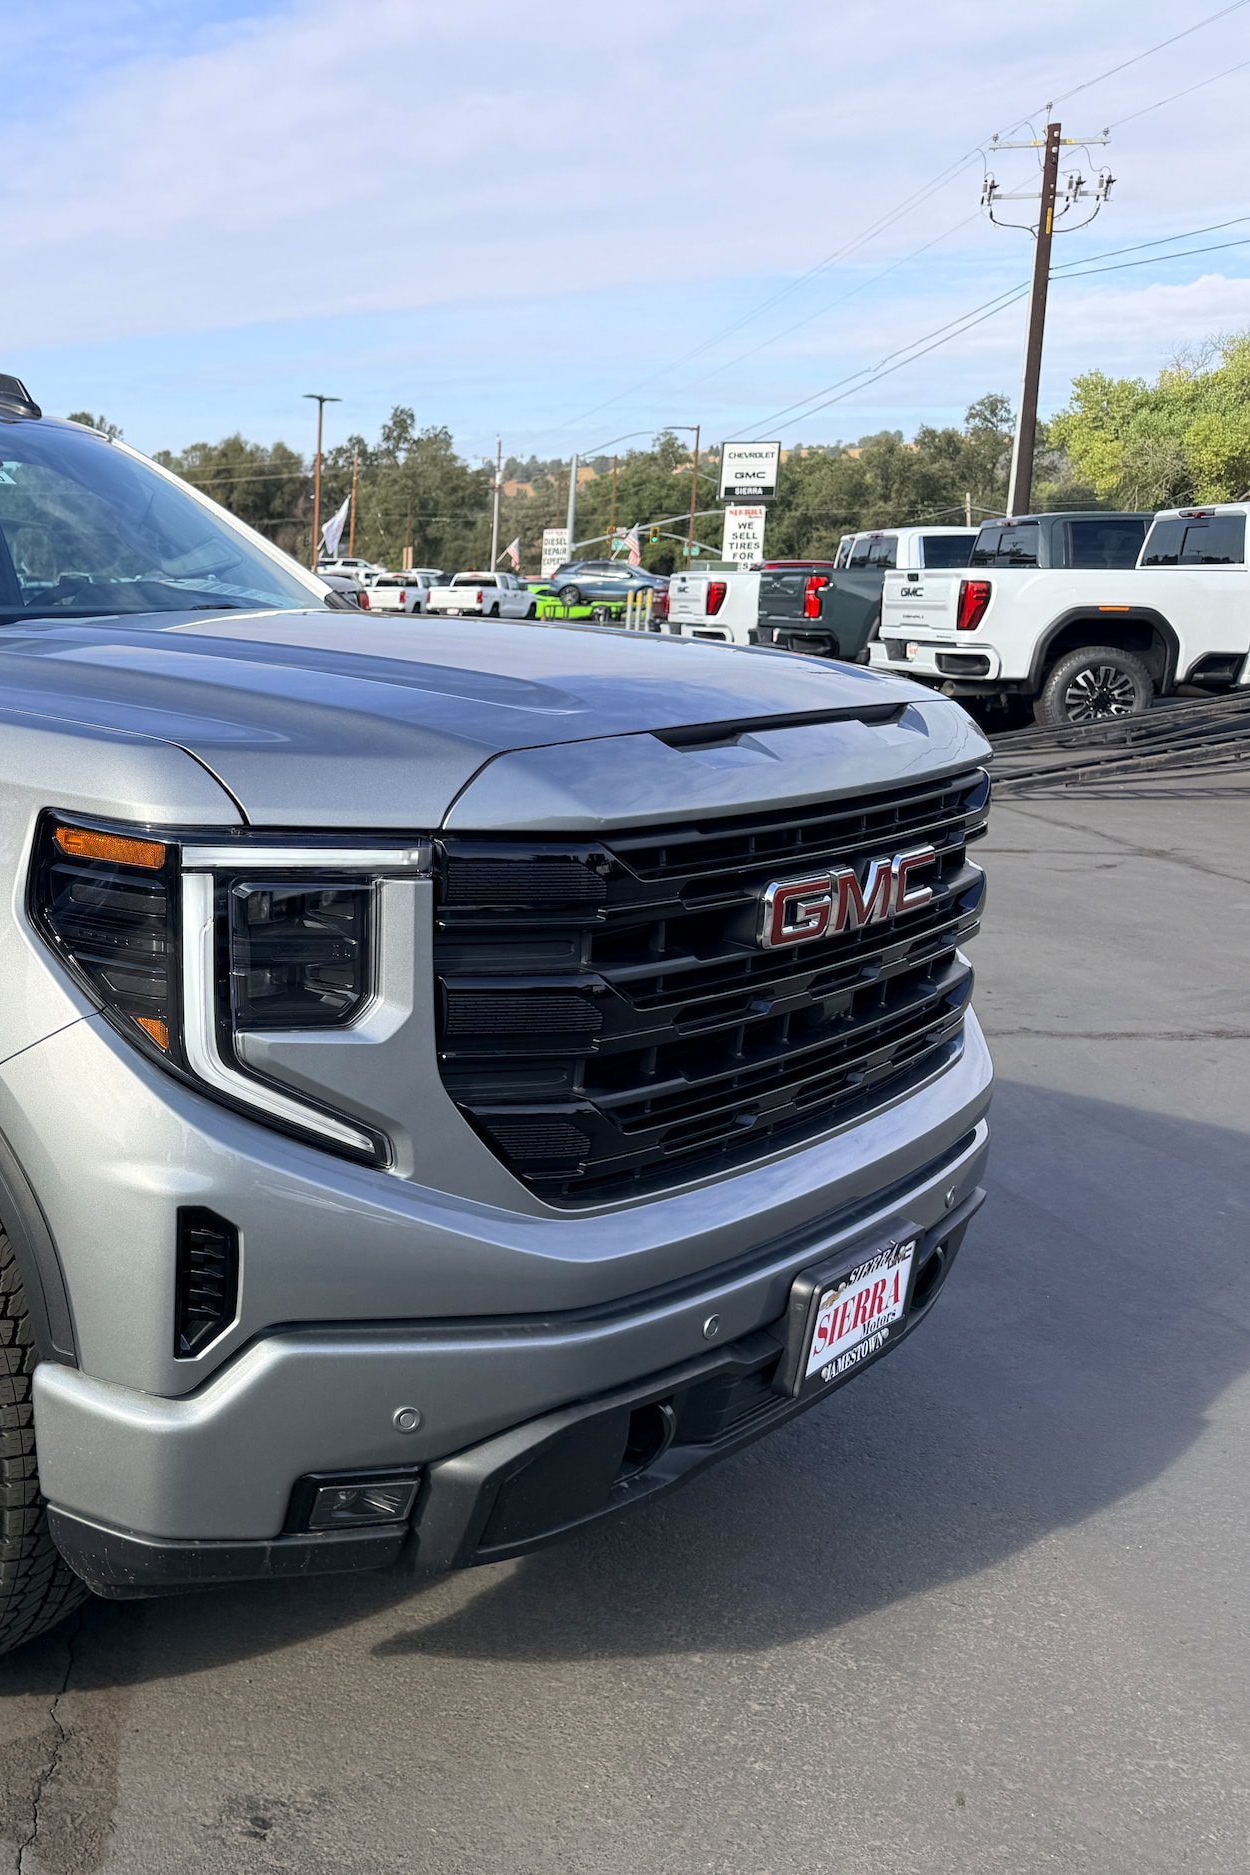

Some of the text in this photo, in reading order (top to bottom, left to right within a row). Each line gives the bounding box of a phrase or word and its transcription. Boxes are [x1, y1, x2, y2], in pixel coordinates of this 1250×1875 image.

[728, 451, 775, 460] CHEVROLET
[734, 471, 766, 479] GMC
[734, 487, 763, 495] SIERRA
[737, 521, 754, 530] WE
[732, 532, 758, 540] SELL
[728, 542, 760, 550] TIRES
[732, 552, 754, 560] FOR
[900, 587, 924, 597] GMC
[762, 843, 936, 950] GMC
[848, 1243, 899, 1284] SIERRA
[813, 1269, 901, 1357] SIERRA
[860, 1308, 896, 1340] Motors
[825, 1331, 884, 1382] JAMESTOWN
